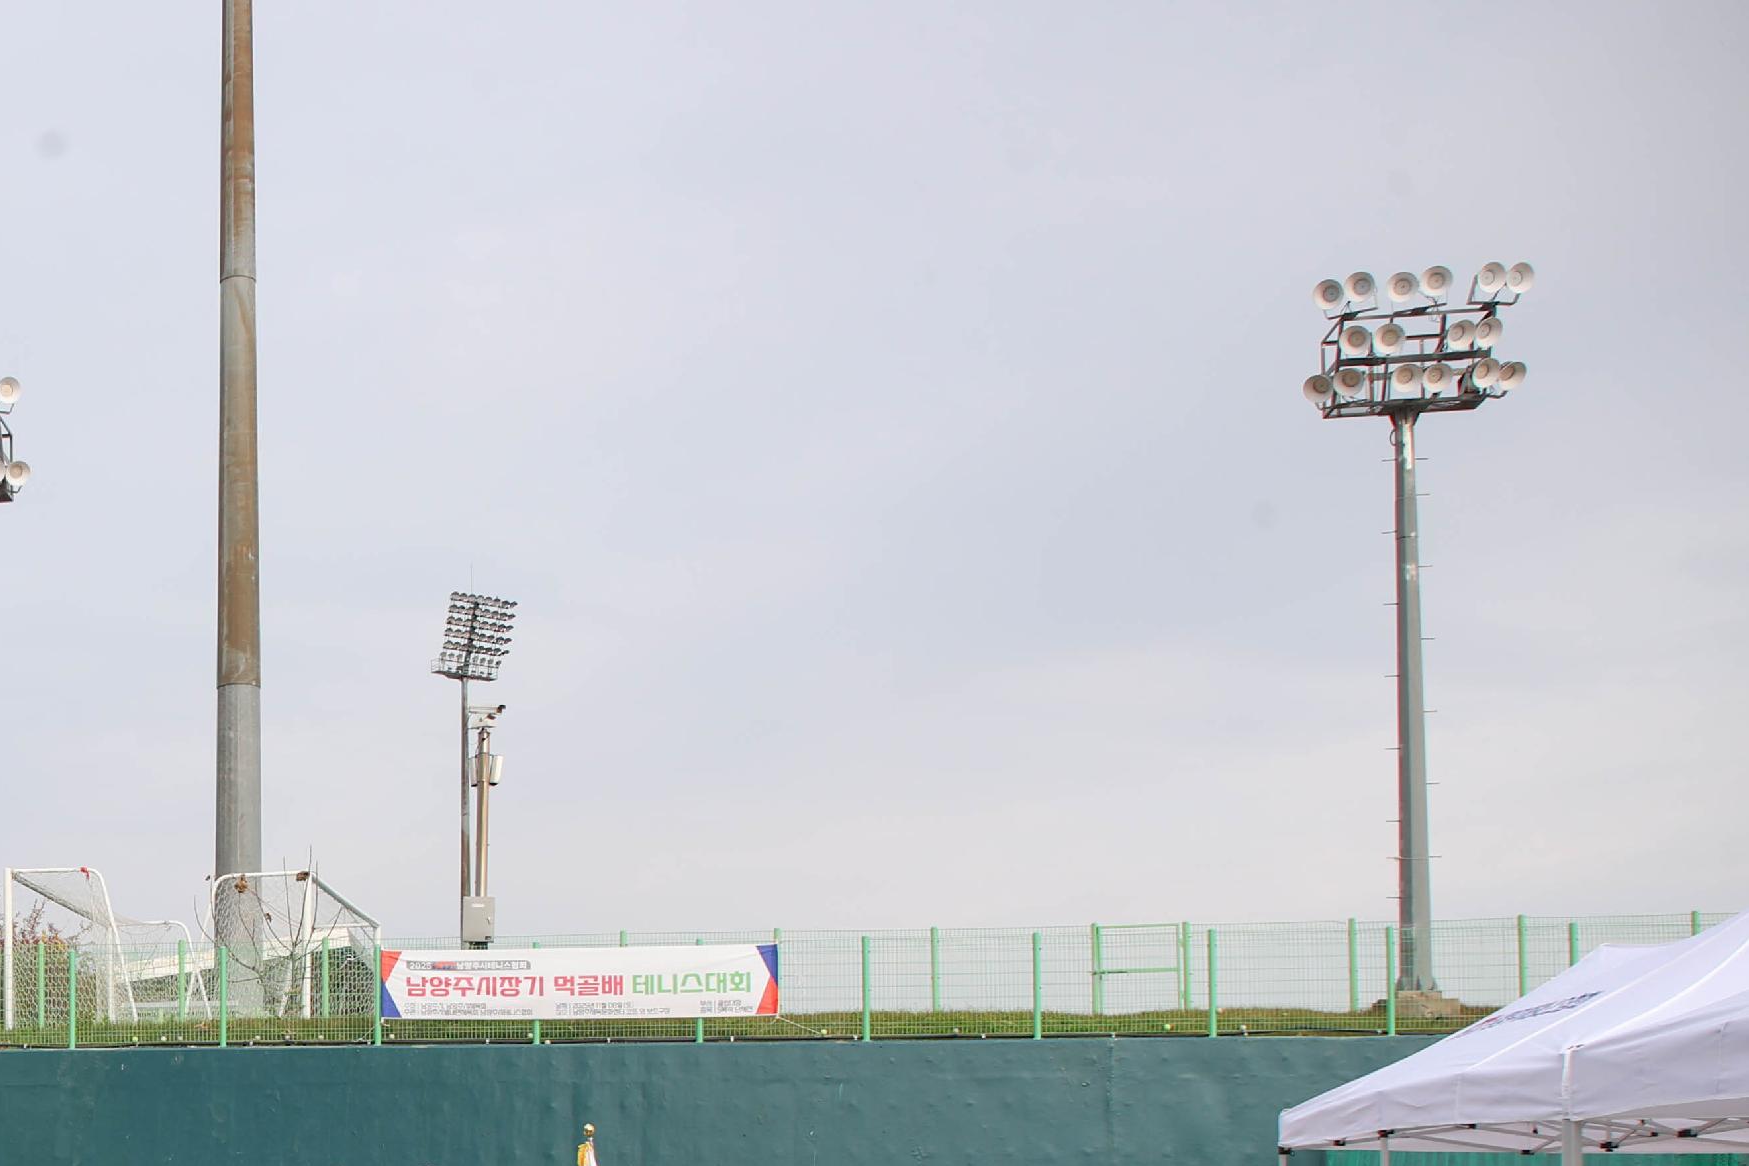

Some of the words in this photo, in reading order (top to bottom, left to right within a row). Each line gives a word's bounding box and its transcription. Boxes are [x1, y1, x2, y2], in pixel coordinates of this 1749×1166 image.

[406, 976, 544, 997] 남양주시장기
[553, 974, 623, 996] 먹골배
[632, 970, 751, 995] 테니스대회
